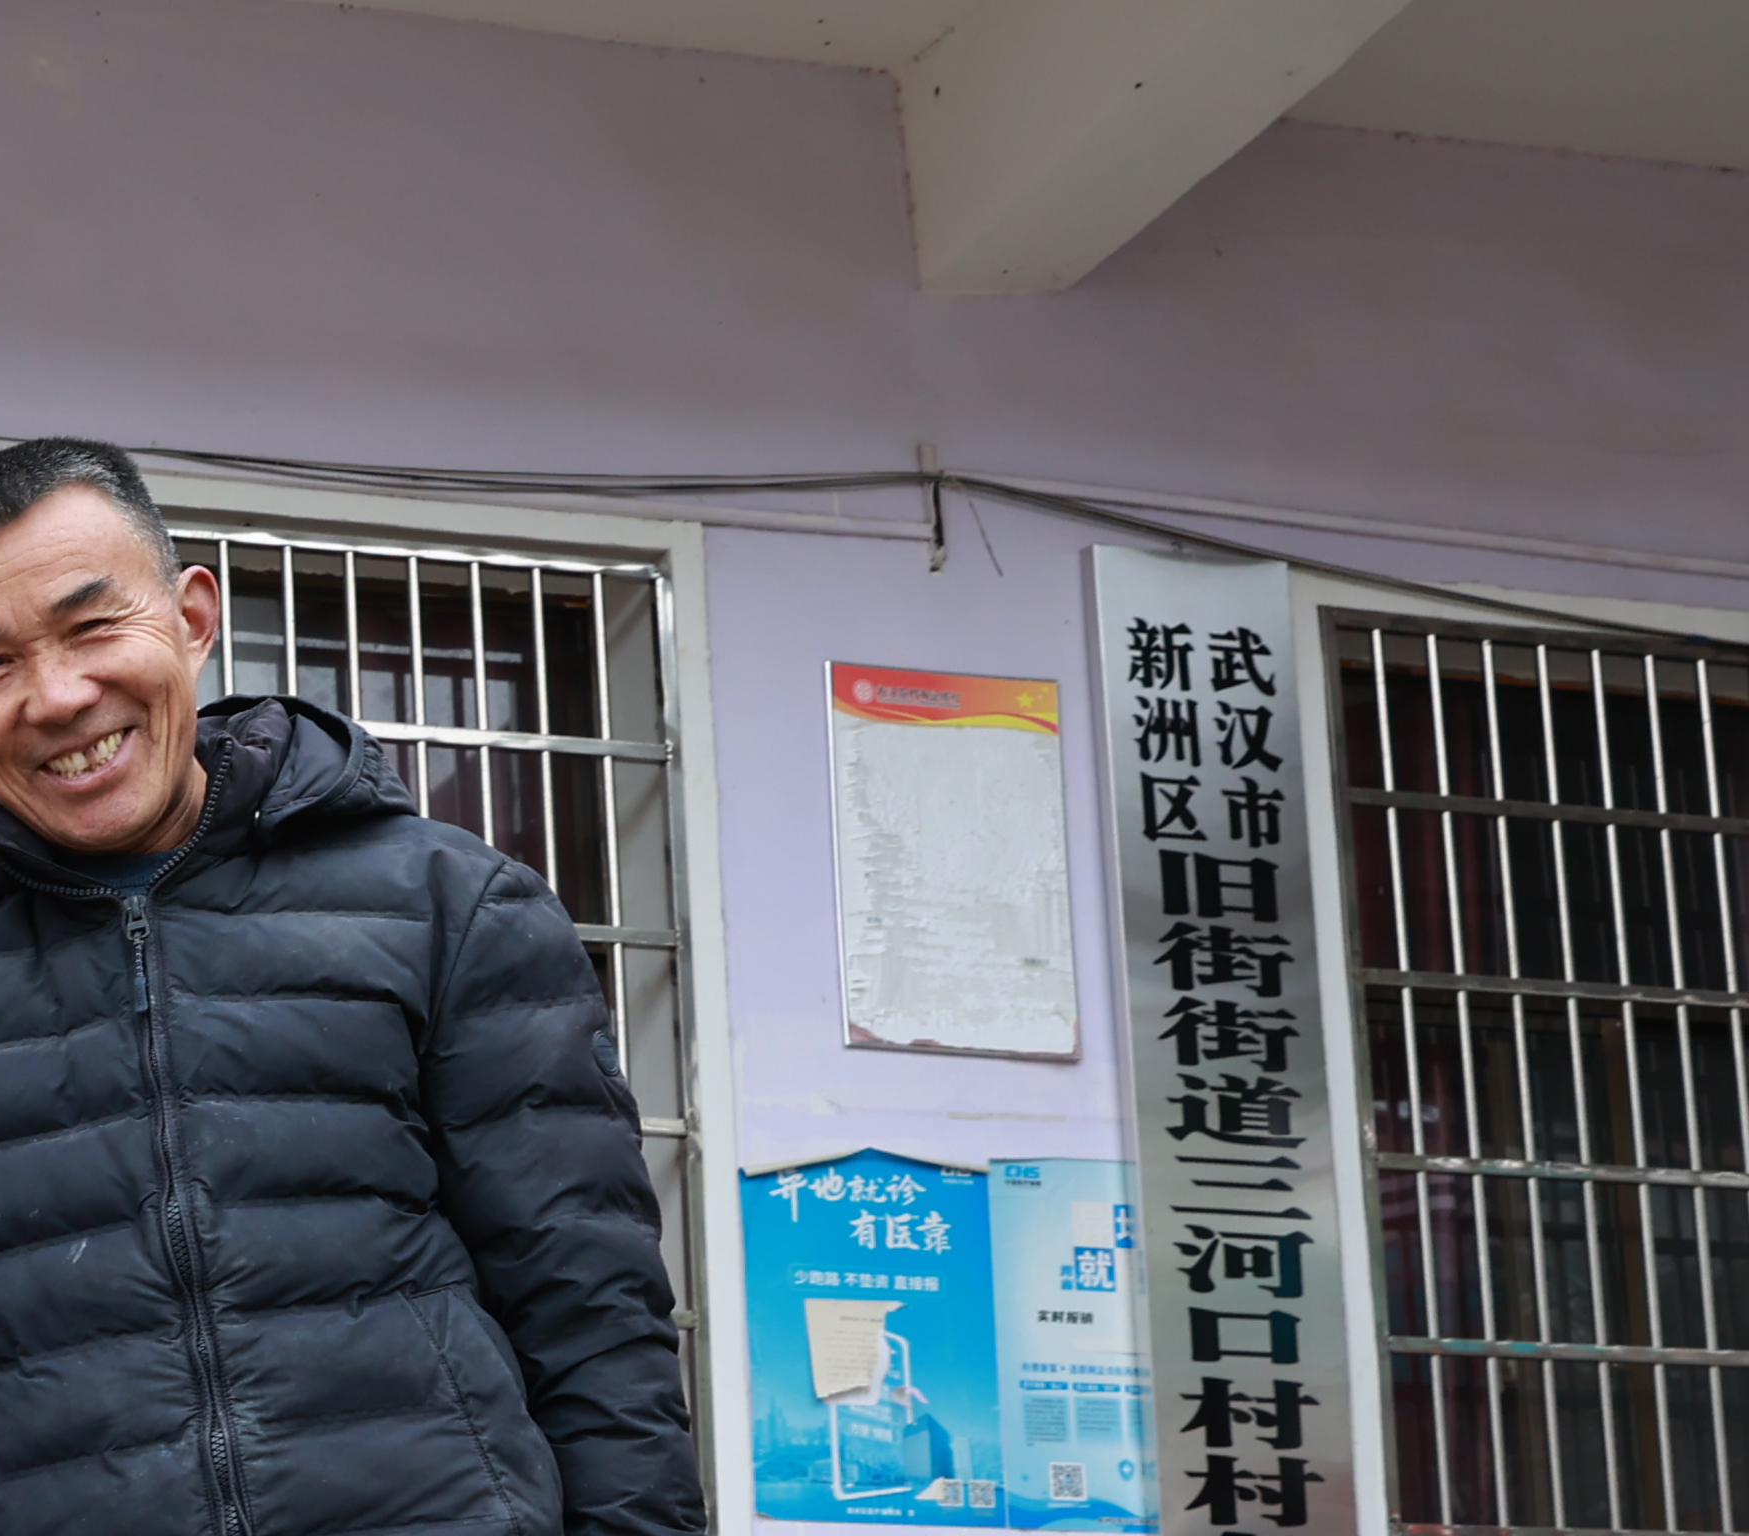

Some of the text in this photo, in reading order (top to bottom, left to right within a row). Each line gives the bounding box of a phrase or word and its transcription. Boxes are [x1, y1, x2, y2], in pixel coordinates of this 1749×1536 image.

[1127, 617, 1208, 844] 新洲区
[1210, 626, 1285, 848] 武汉市
